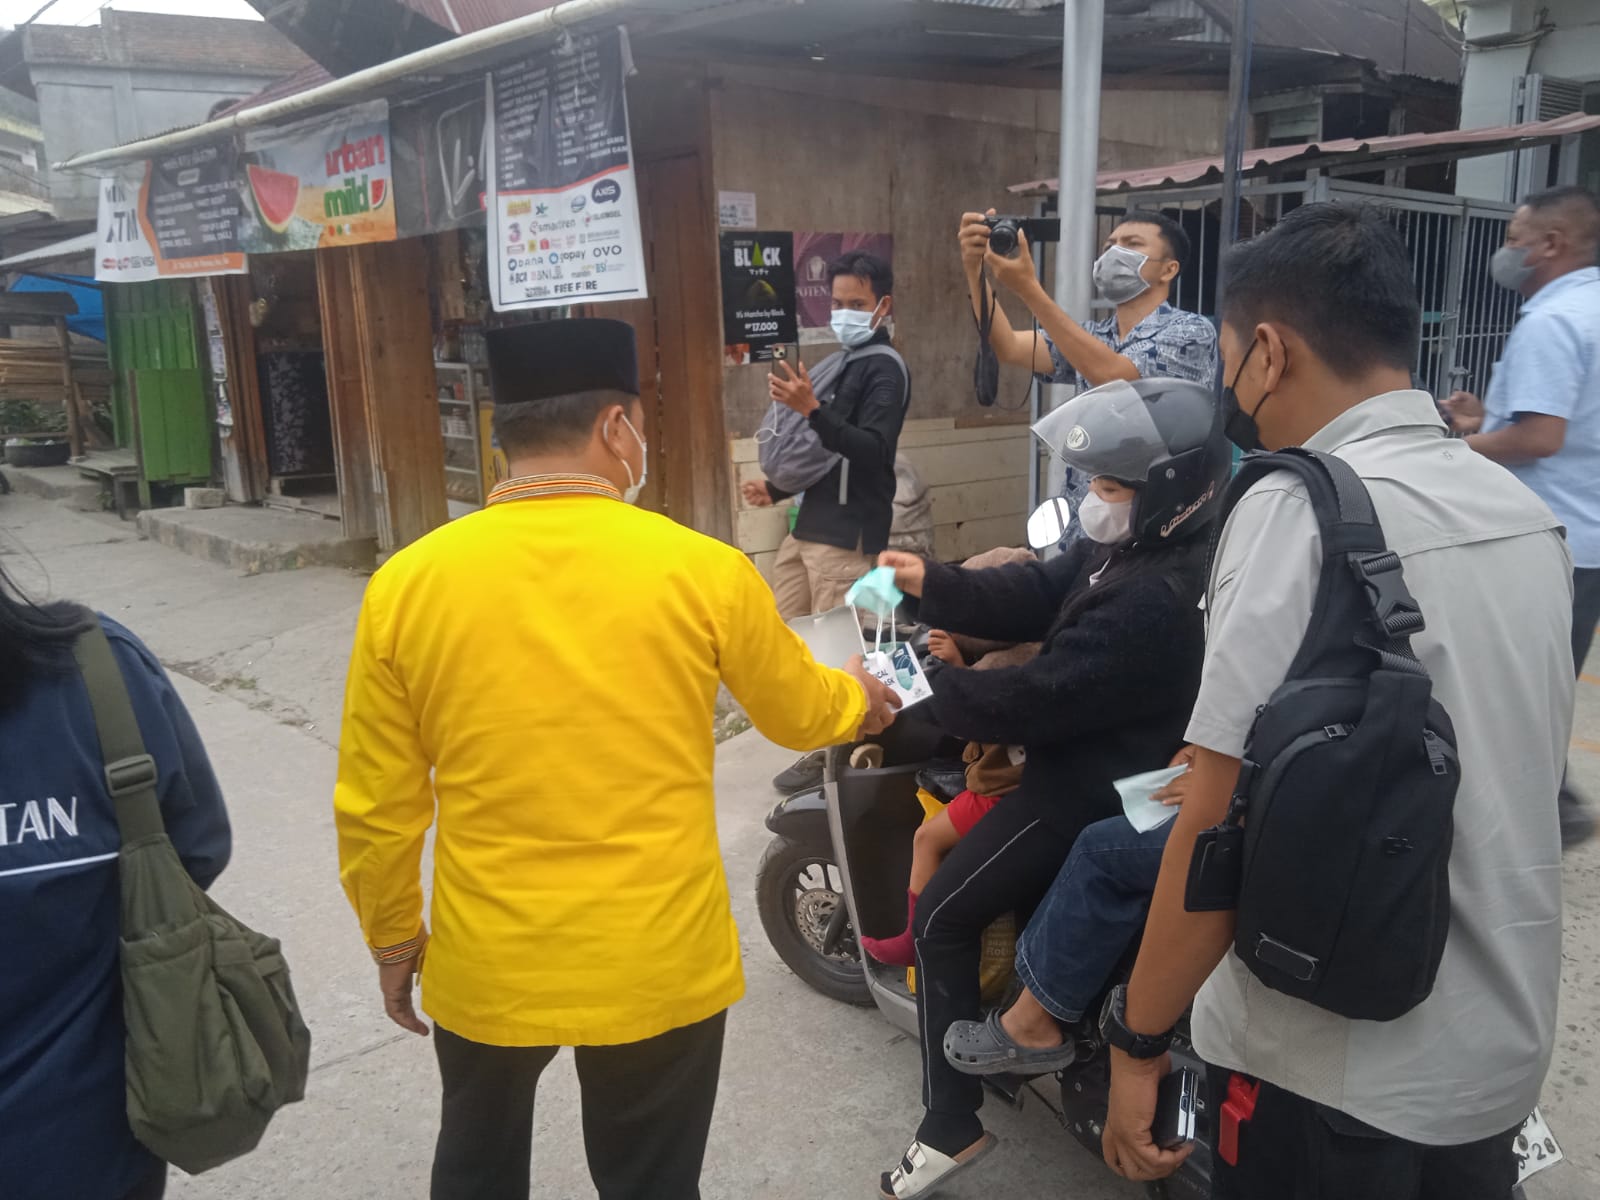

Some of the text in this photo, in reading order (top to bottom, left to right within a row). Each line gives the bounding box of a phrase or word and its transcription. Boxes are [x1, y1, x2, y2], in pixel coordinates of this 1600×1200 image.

[325, 133, 386, 177] urban
[323, 174, 370, 219] mild
[594, 185, 616, 197] AXIS
[593, 245, 622, 258] OVO
[733, 241, 781, 267] BLACK
[554, 282, 573, 294] FREE
[752, 321, 778, 332] 17.000
